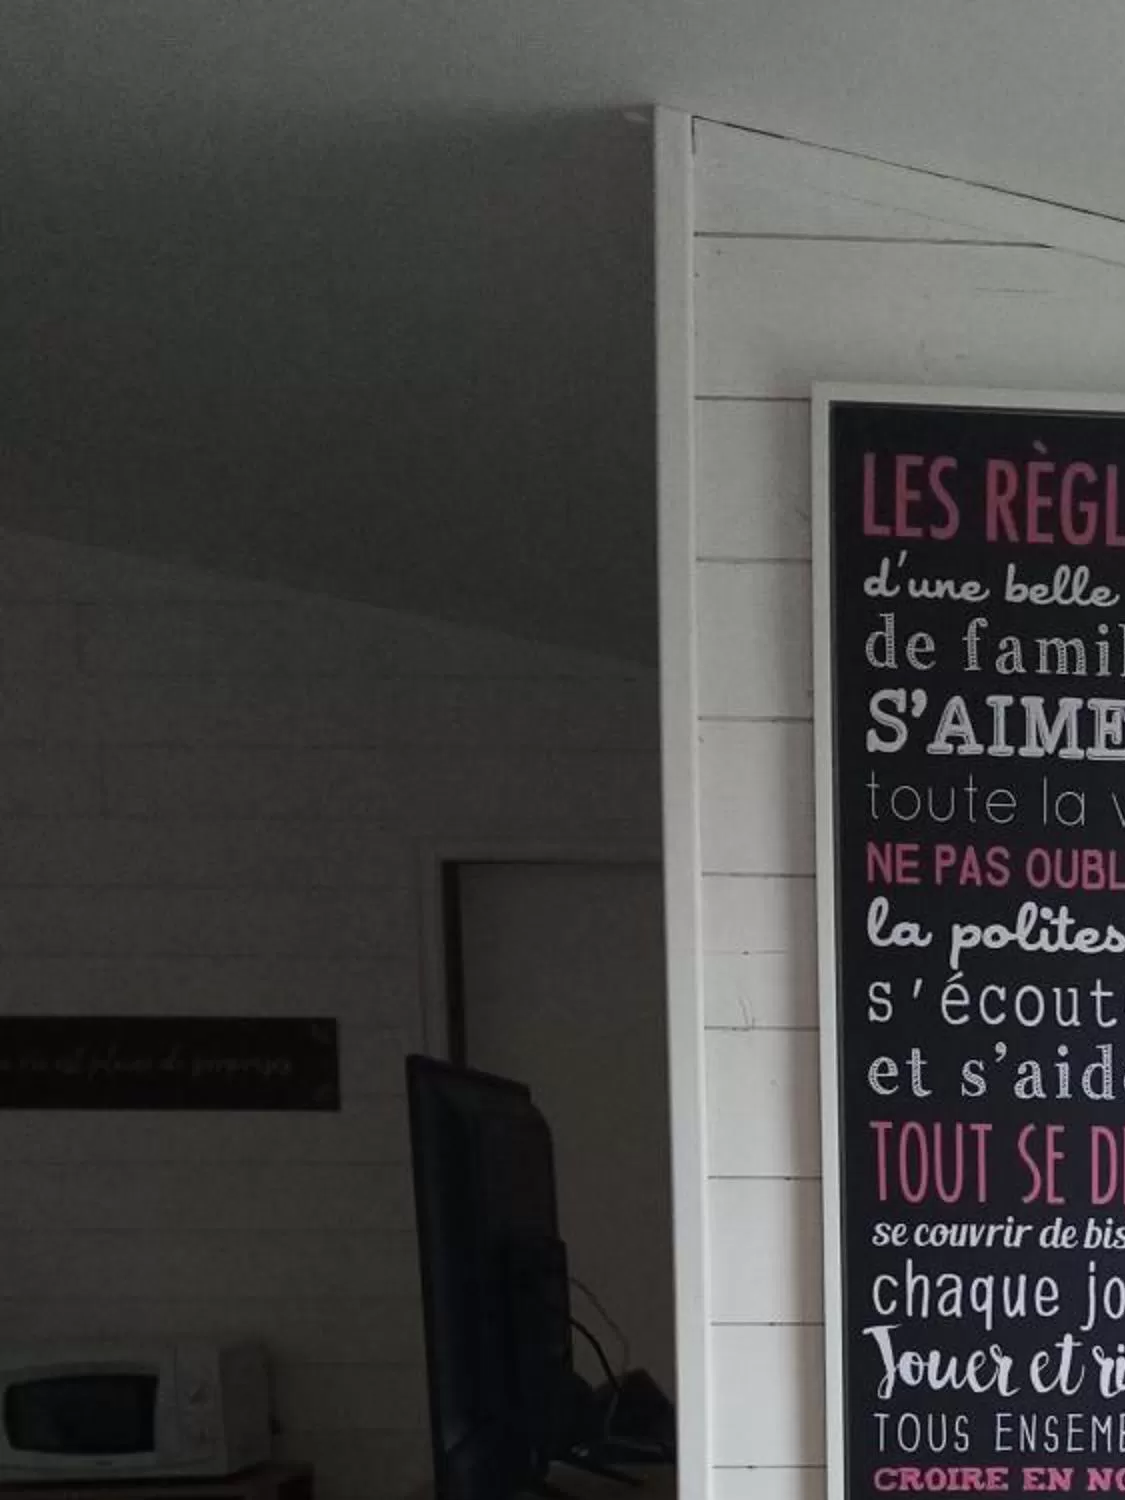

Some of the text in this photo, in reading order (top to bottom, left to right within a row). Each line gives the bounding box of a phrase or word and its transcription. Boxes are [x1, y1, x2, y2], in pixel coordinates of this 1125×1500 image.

[864, 454, 959, 540] LES
[864, 550, 990, 602] d'une
[1005, 563, 1120, 607] belle
[866, 613, 936, 670] de
[866, 770, 1016, 824] toute
[1044, 777, 1085, 826] la
[868, 842, 920, 884] NE
[936, 844, 1010, 887] PAS
[867, 896, 932, 946] la
[868, 1048, 931, 1097] et
[870, 1121, 992, 1203] TOUT
[1018, 1124, 1064, 1204] SE
[872, 1223, 908, 1246] se
[914, 1216, 1033, 1247] couvrir
[1040, 1218, 1078, 1248] de
[873, 1259, 1059, 1330] chaque
[863, 1324, 1019, 1399] Jouer
[1030, 1333, 1085, 1395] et
[874, 1413, 969, 1452] TOUS
[875, 1467, 1008, 1491] CROIRE
[1023, 1468, 1074, 1491] EN
